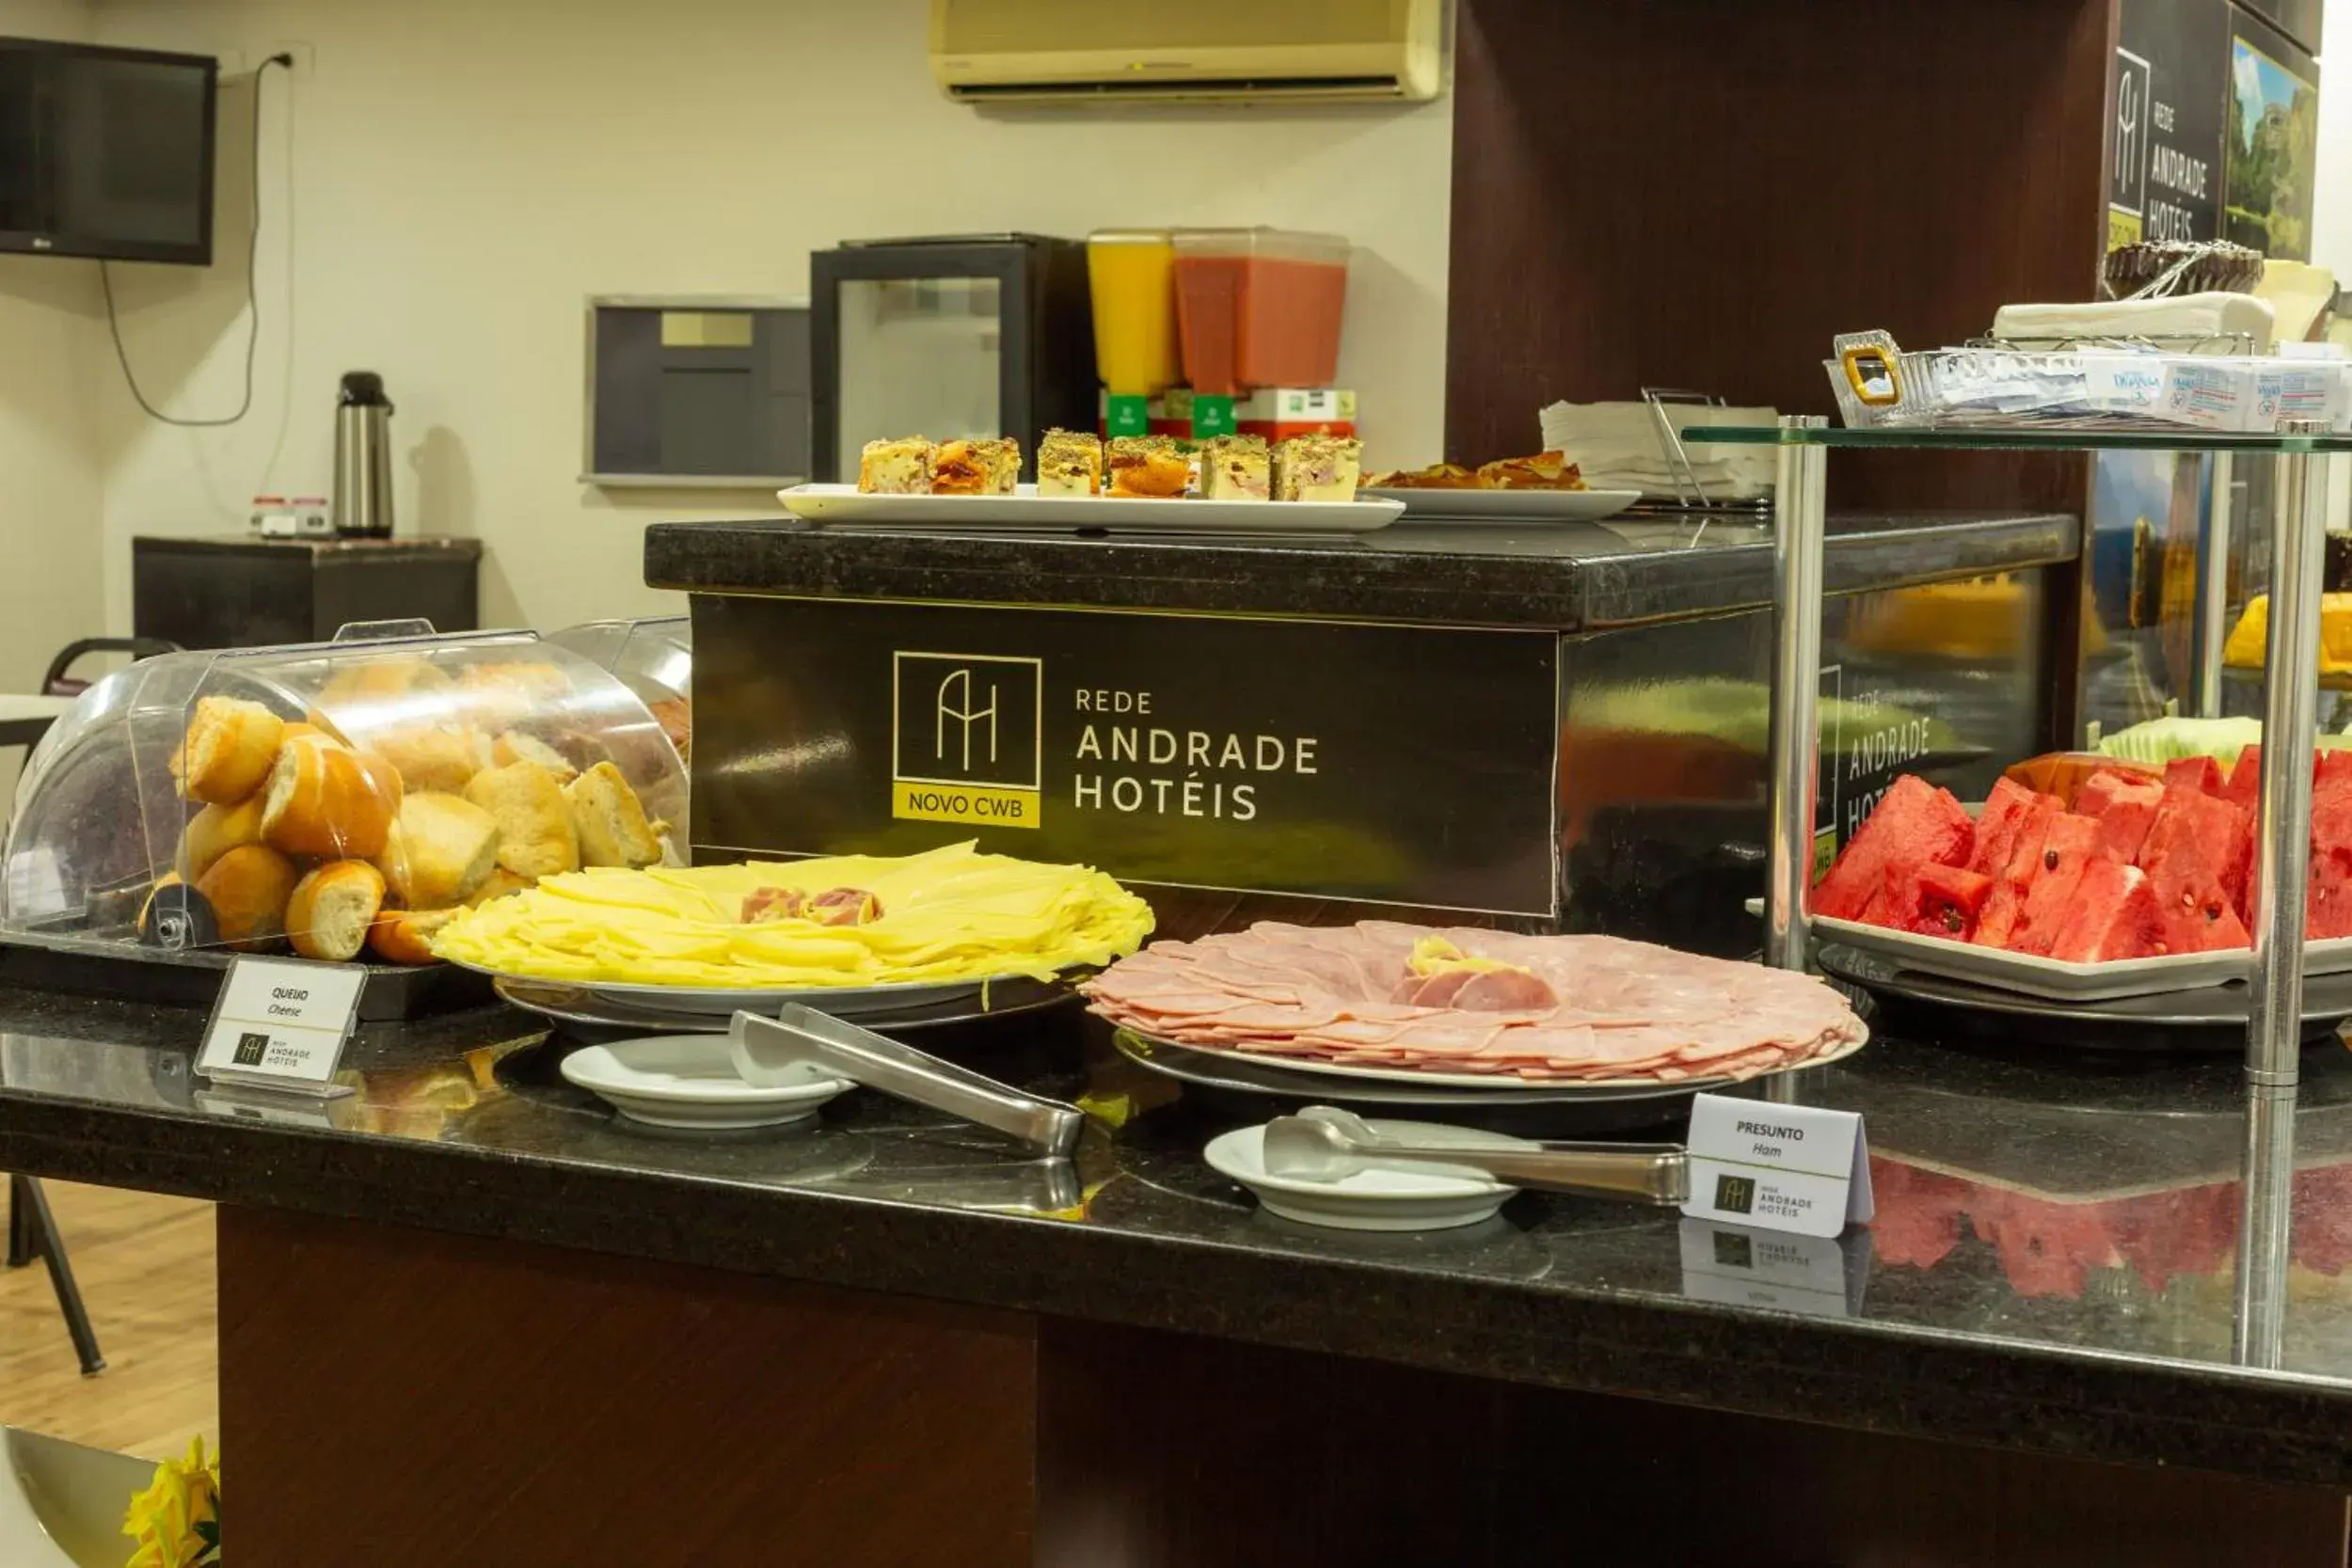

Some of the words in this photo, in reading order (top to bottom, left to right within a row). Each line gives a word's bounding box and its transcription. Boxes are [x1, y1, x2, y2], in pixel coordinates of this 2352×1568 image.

[2151, 143, 2207, 200] ANDRADE
[1076, 689, 1152, 715] REDE
[1076, 725, 1318, 774] ANDRADE
[1849, 716, 1931, 782] ANDRADE
[909, 792, 968, 815] NOVO
[975, 798, 1023, 817] CWB
[1074, 770, 1257, 821] HOTÉIS
[1737, 1120, 1804, 1141] PRESUNTO
[1753, 1143, 1782, 1158] Ham
